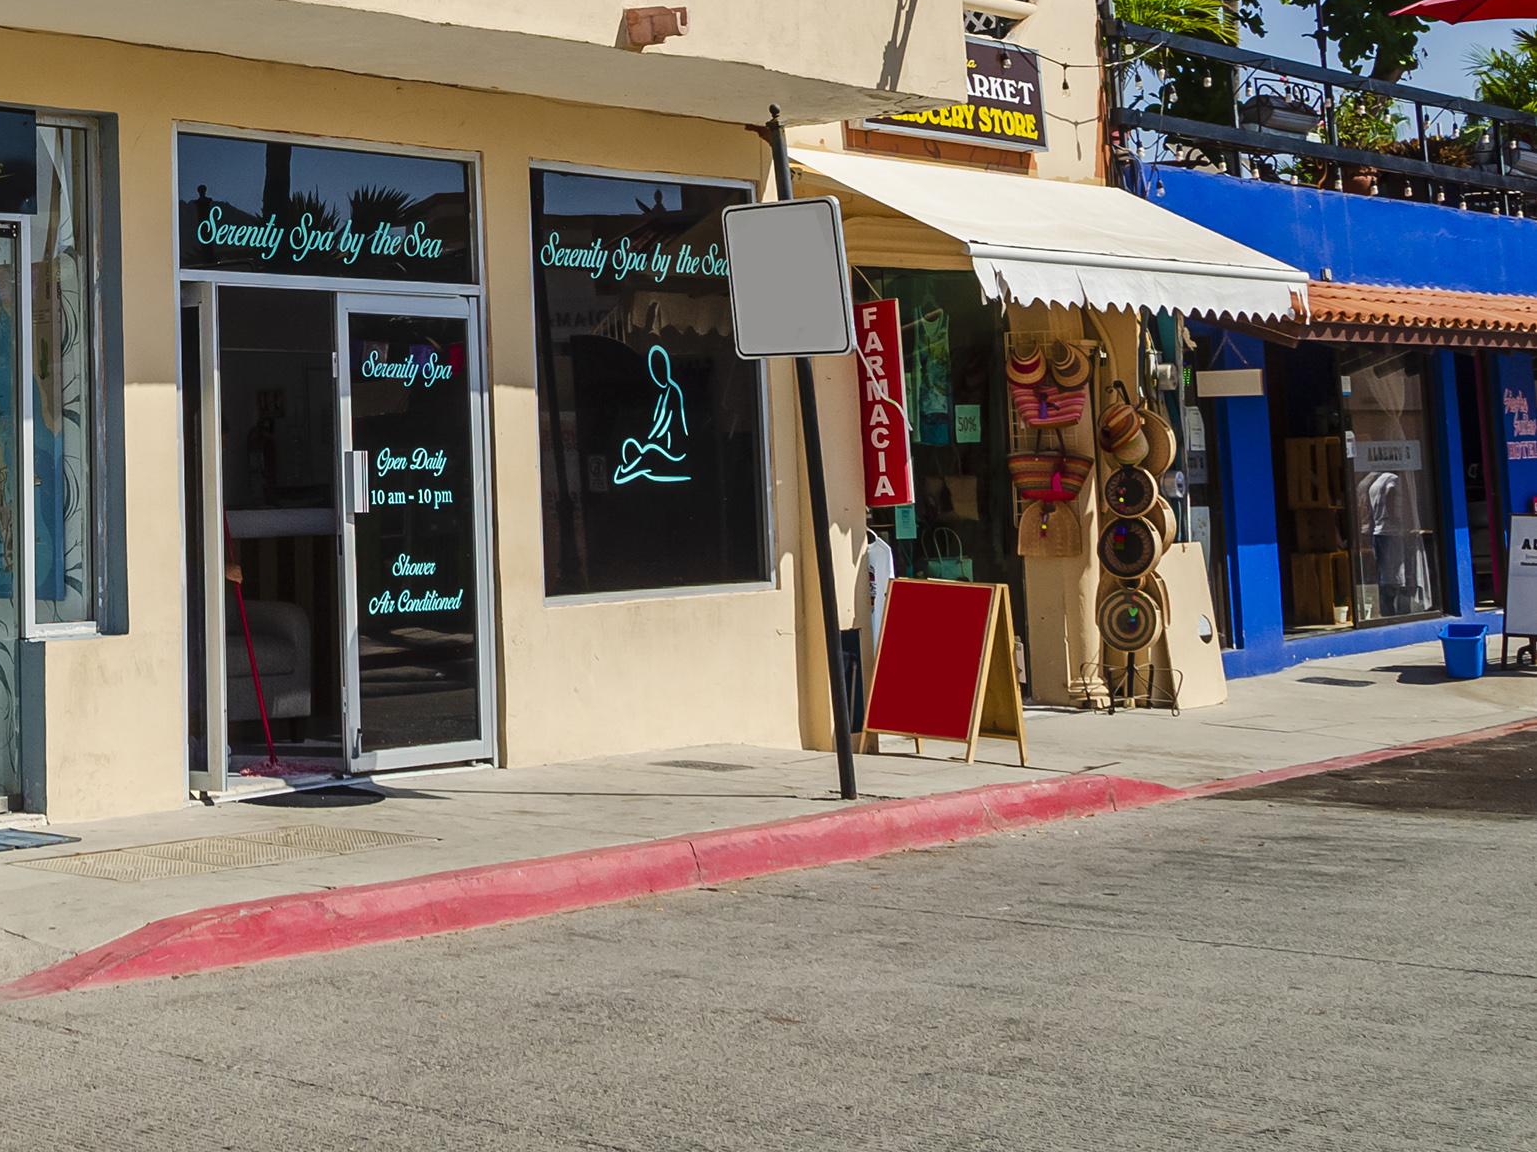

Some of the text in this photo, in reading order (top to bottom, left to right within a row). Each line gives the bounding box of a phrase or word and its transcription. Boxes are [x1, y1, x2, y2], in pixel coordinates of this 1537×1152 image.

[978, 106, 1039, 140] STORE
[197, 206, 443, 265] Serenity Spa by the Sea
[540, 232, 609, 279] Serenity
[612, 236, 648, 281] Spa
[650, 242, 672, 283] by
[675, 244, 701, 274] the
[362, 350, 453, 387] Serenity Spa
[862, 307, 895, 498] FARMACIA
[958, 415, 977, 432] 50%
[377, 448, 448, 476] Open Daily
[371, 489, 385, 504] 10
[388, 491, 406, 504] am
[418, 488, 432, 503] 10
[434, 489, 453, 509] pm
[392, 553, 436, 577] Shower
[368, 588, 464, 614] Air Conditioned
